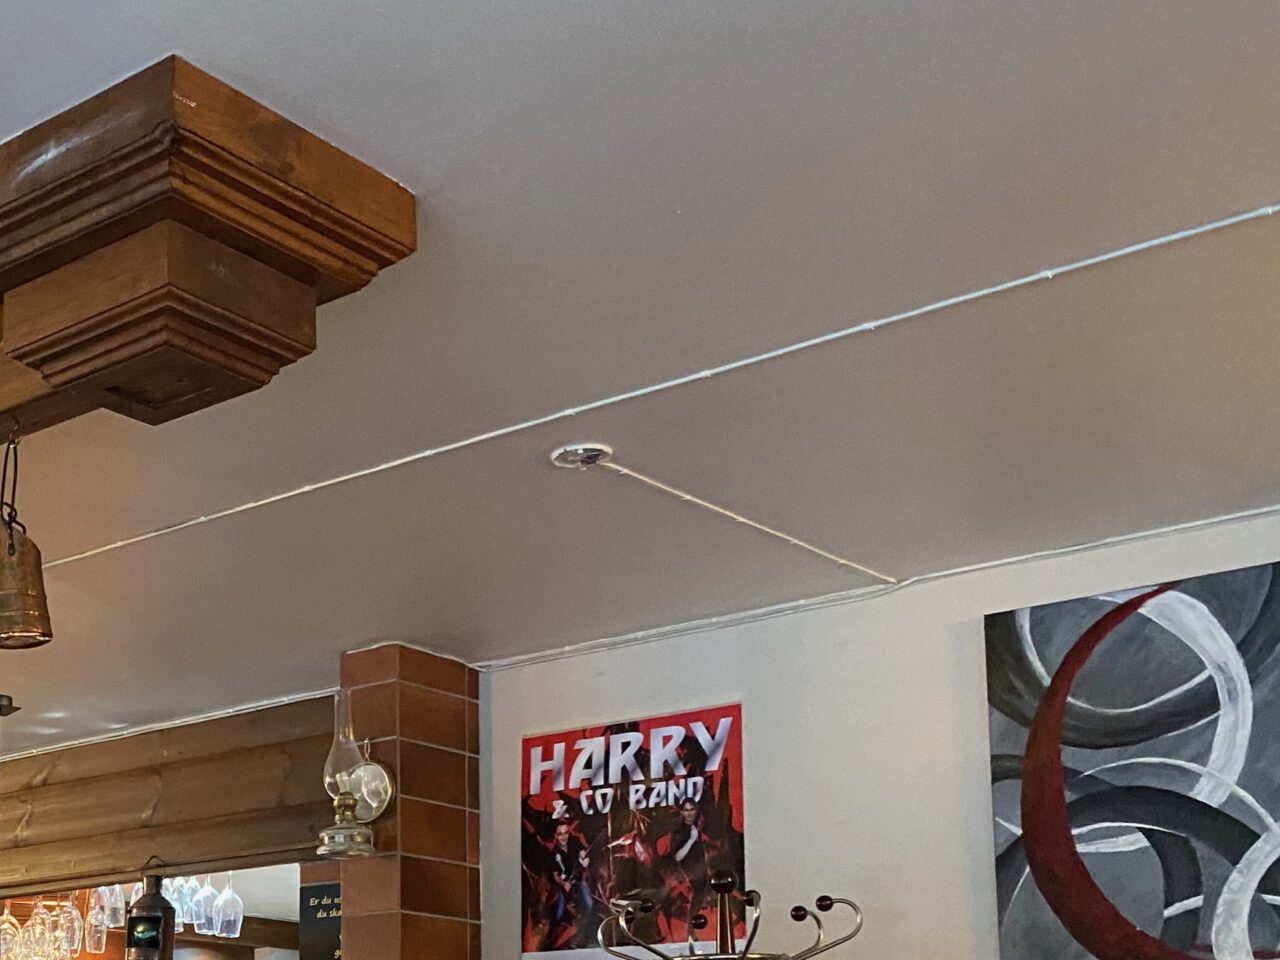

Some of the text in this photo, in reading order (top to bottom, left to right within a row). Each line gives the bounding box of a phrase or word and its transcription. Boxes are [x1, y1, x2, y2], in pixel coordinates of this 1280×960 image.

[529, 716, 733, 795] HARRY
[551, 776, 705, 820] & CO BAND
[309, 897, 320, 906] Er
[321, 895, 332, 905] du
[316, 909, 327, 919] du
